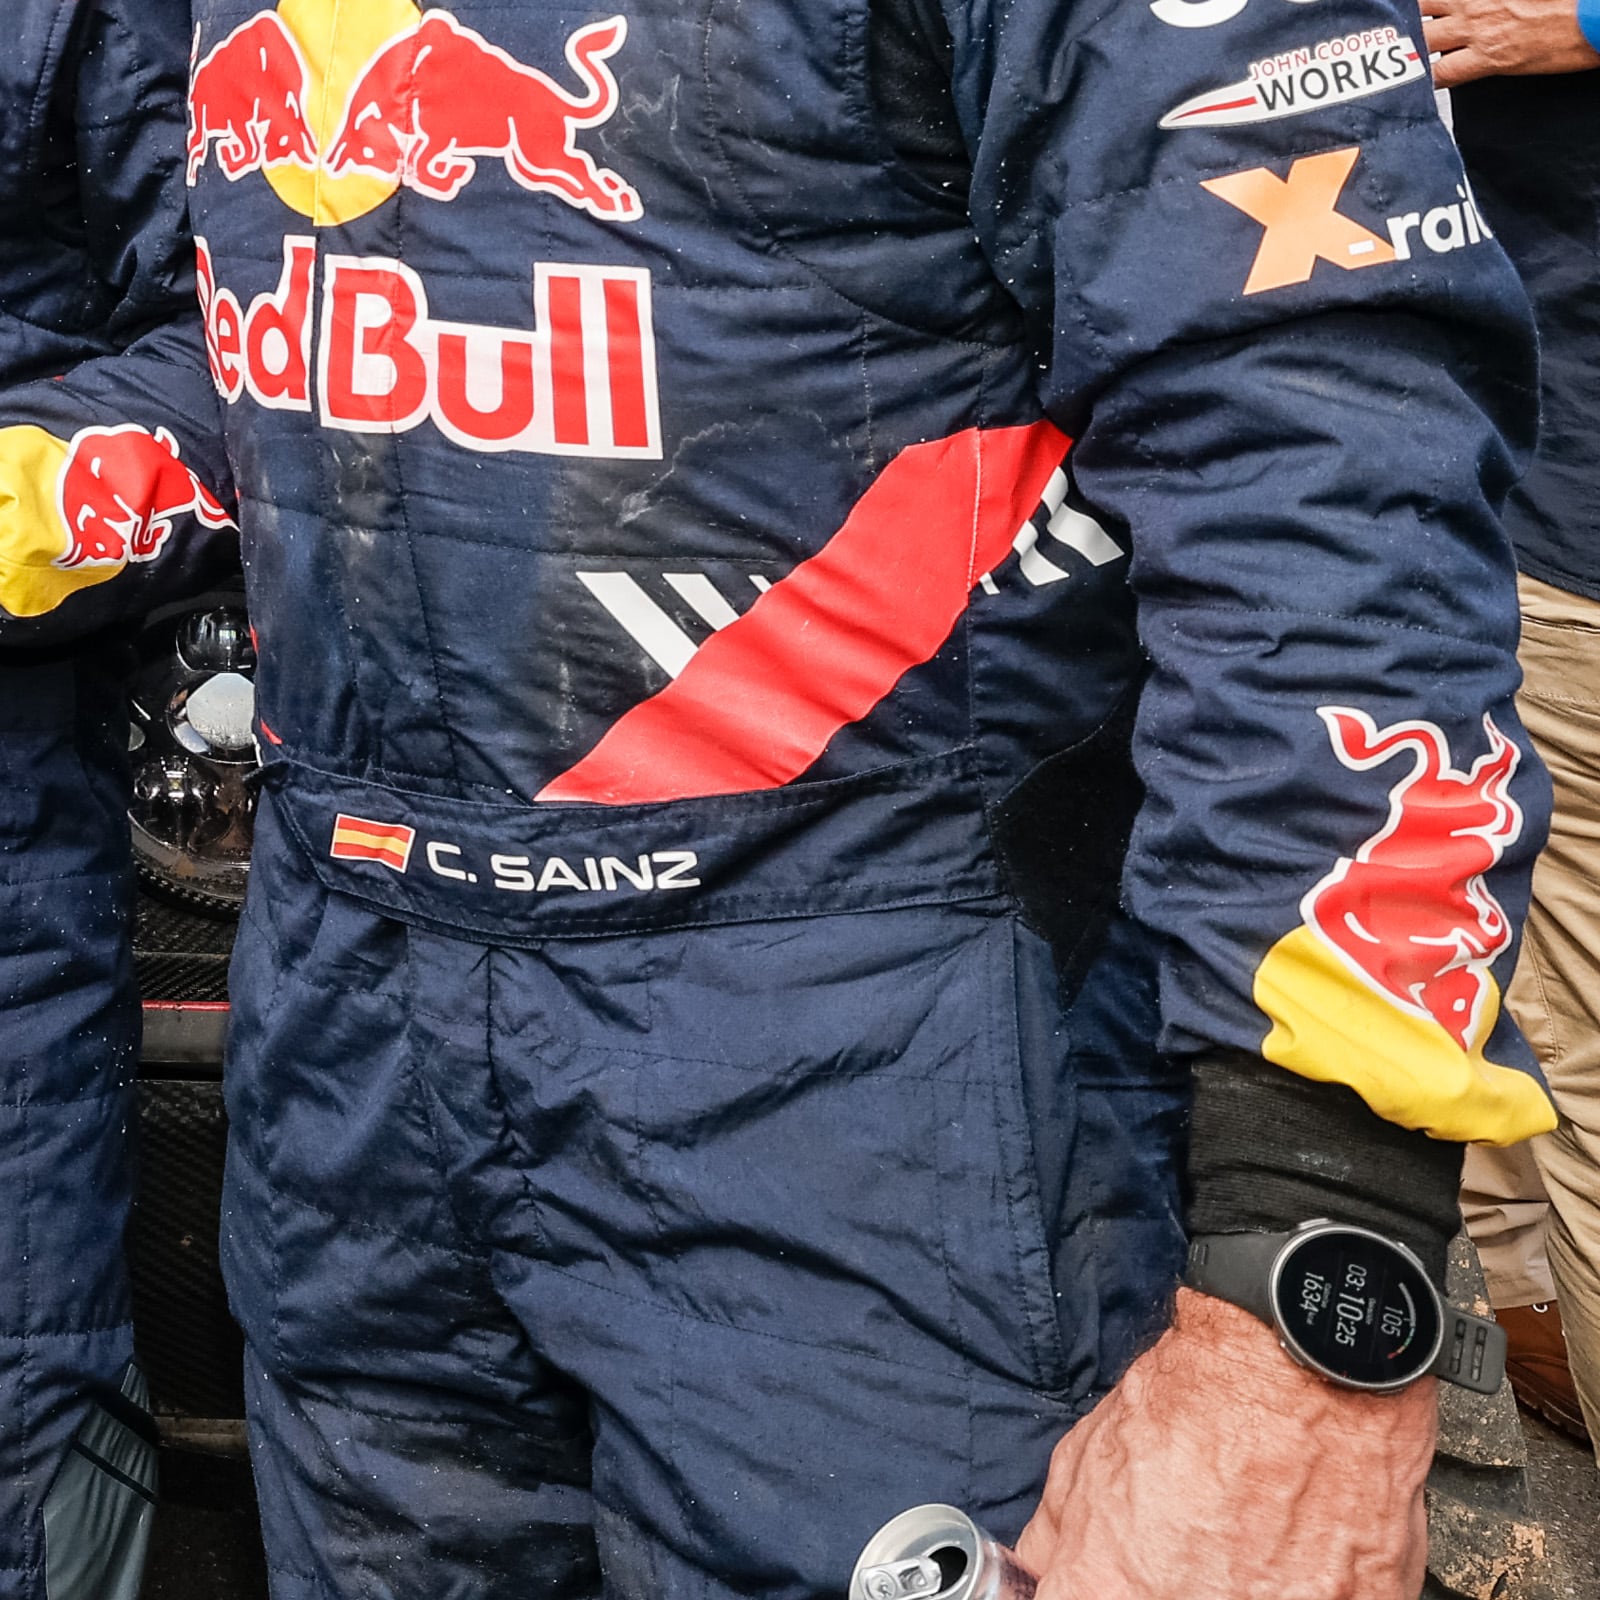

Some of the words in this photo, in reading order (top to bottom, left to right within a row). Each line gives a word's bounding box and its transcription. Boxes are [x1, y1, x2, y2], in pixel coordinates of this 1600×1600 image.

[1249, 50, 1311, 82] JOHN
[1316, 26, 1399, 62] COOPER
[1256, 46, 1408, 112] WORKS
[318, 255, 662, 460] Bull
[427, 843, 477, 884] C.
[494, 849, 702, 892] SAINZ
[1299, 1271, 1325, 1314] 1634
[1380, 1305, 1405, 1337] 105
